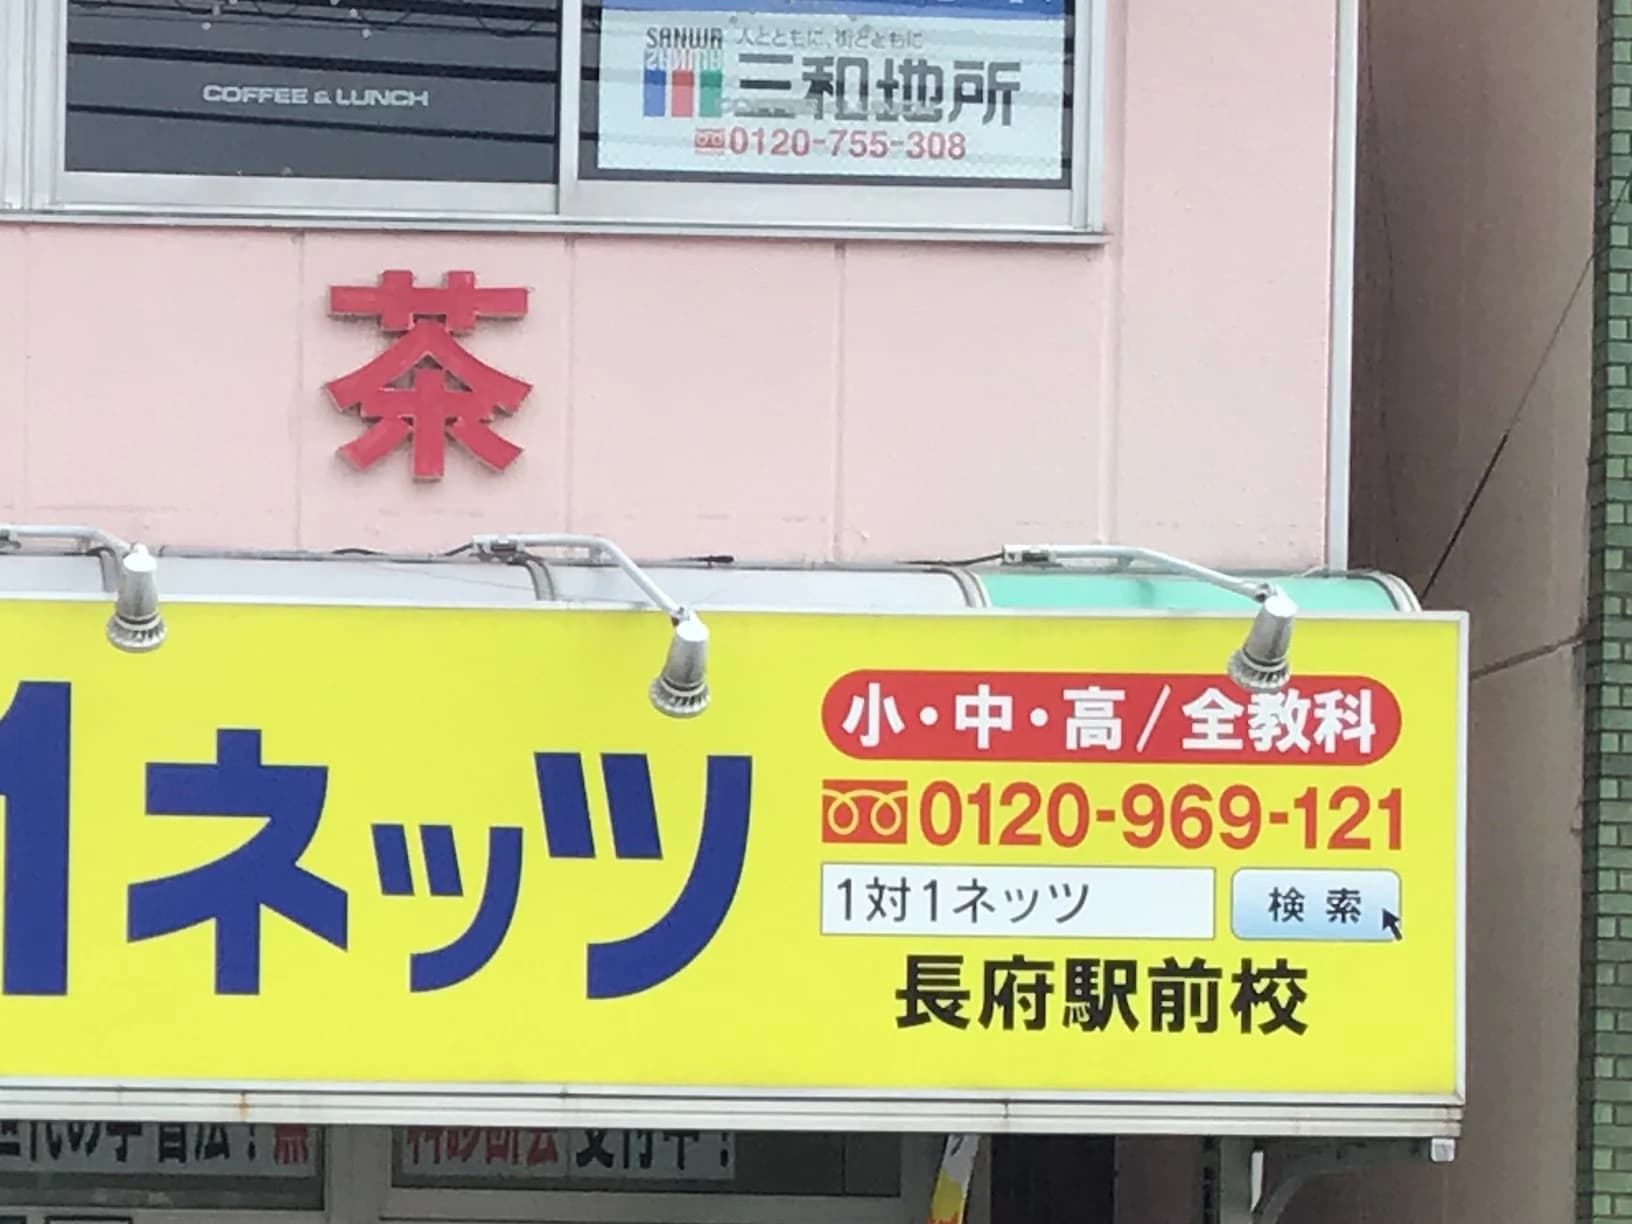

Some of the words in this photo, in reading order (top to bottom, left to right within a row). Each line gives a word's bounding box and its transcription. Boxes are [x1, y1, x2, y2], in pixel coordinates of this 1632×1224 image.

[646, 27, 723, 49] SANWA
[202, 84, 308, 104] COFFEE
[335, 88, 429, 106] LUNCH
[734, 53, 1022, 126] 三和地所
[729, 128, 967, 160] 0120-755-308
[919, 779, 1404, 852] 0120-969-121
[836, 876, 1090, 925] 1対1ネッツ
[894, 953, 1310, 1036] 長府駅前校
